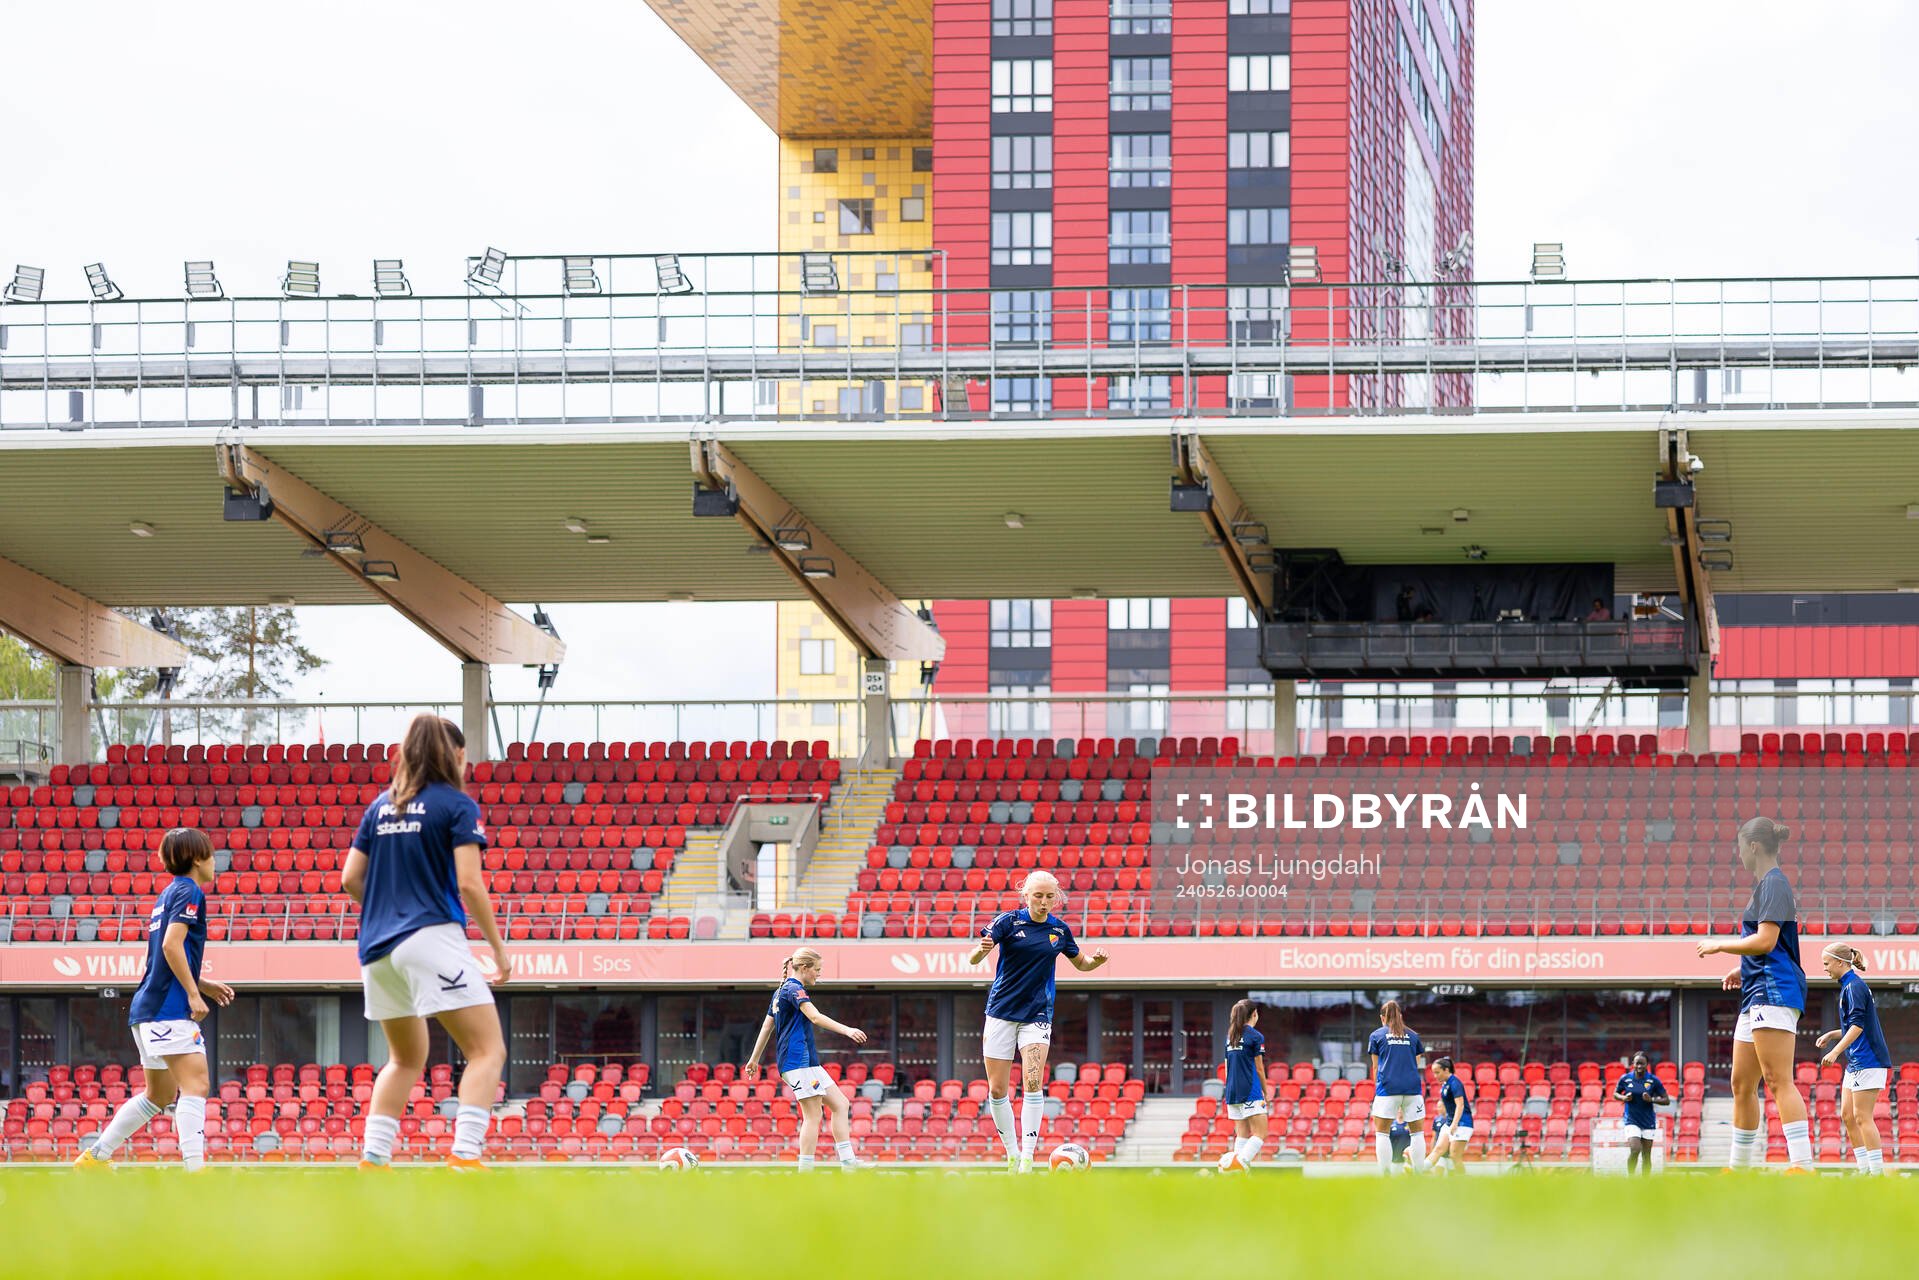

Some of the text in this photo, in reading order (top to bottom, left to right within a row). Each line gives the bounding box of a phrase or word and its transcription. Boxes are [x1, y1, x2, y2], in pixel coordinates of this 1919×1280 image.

[592, 955, 632, 975] Spcs
[1279, 946, 1604, 973] Ekonomisystem för din passion
